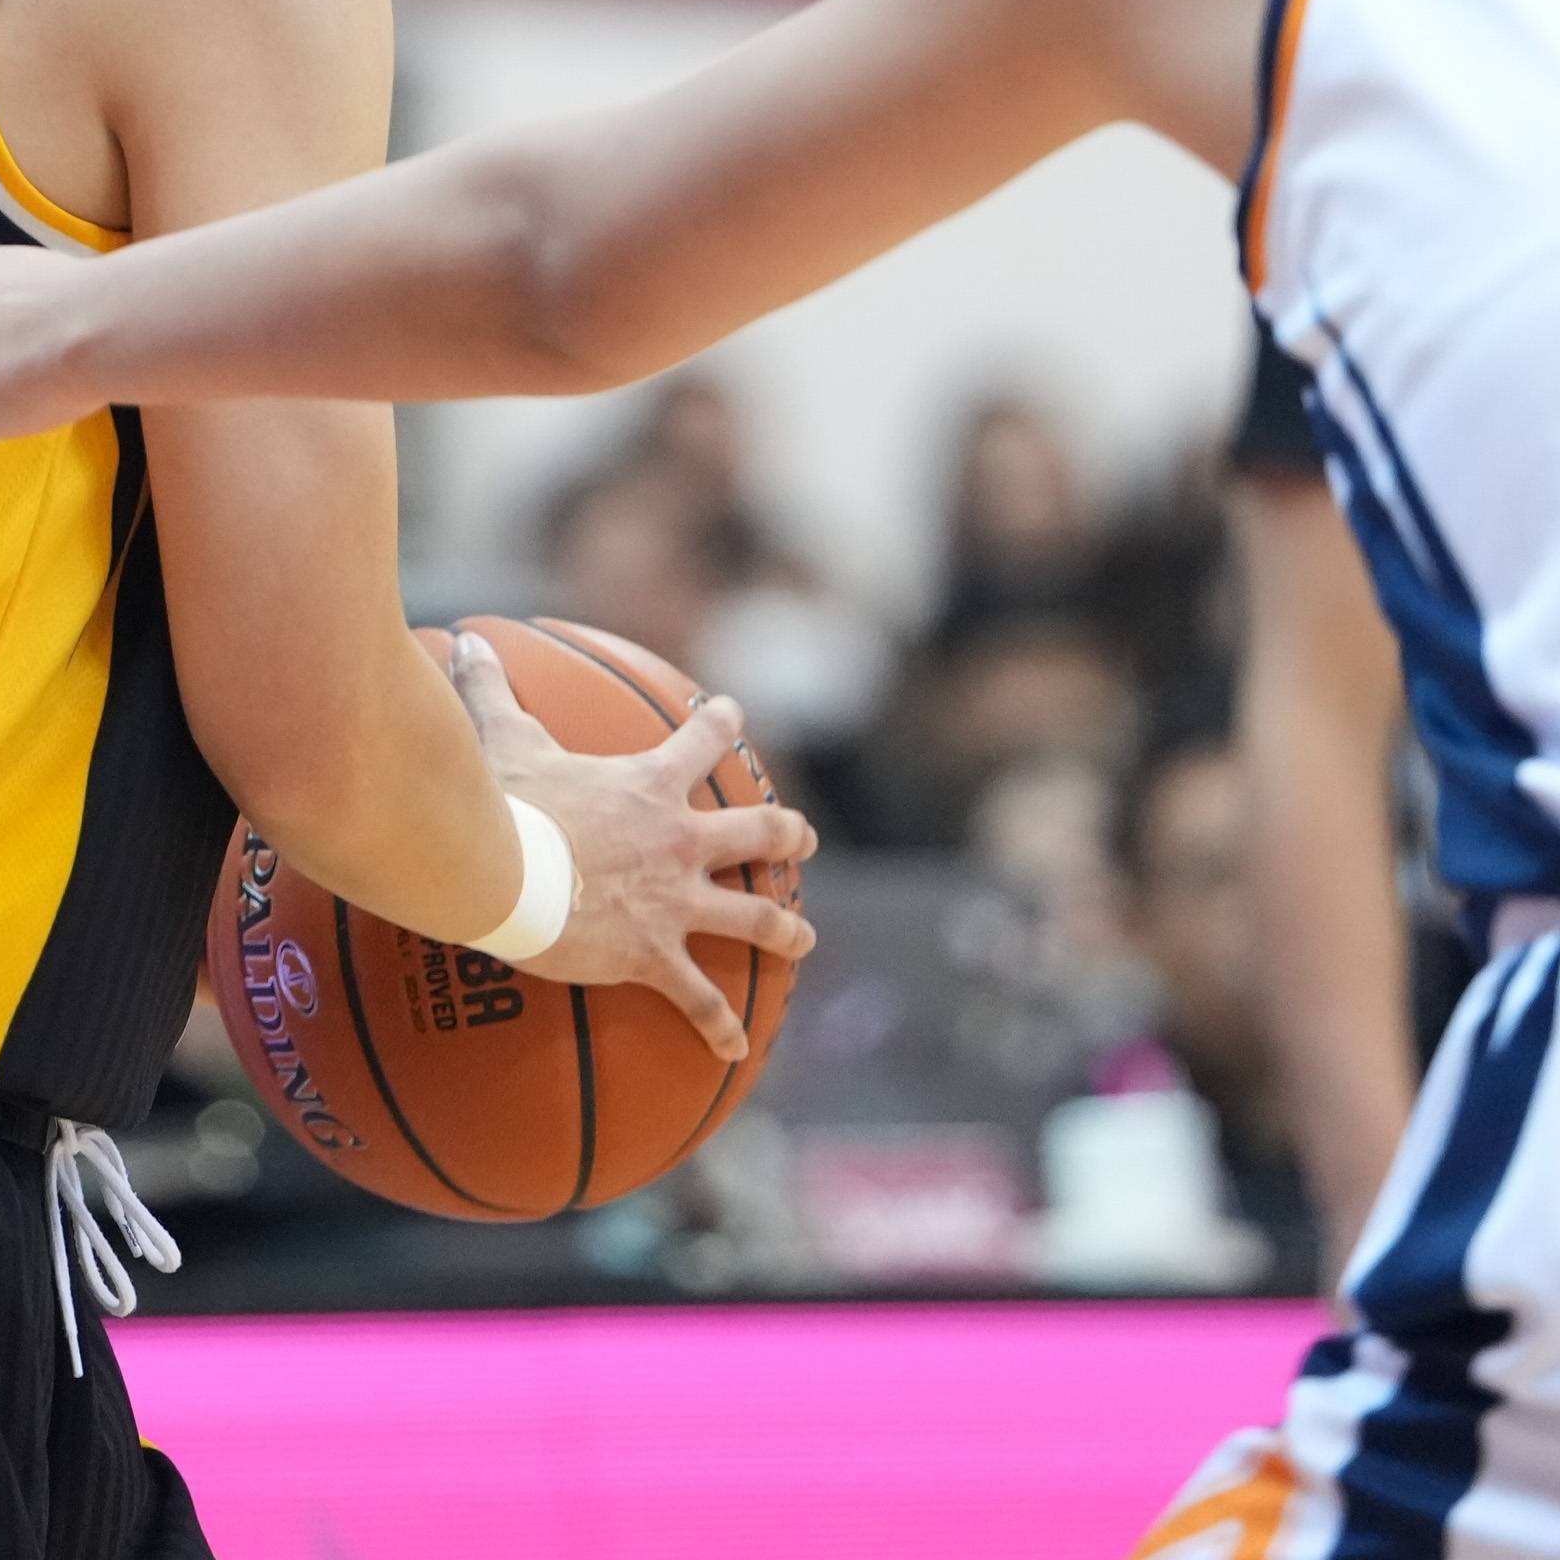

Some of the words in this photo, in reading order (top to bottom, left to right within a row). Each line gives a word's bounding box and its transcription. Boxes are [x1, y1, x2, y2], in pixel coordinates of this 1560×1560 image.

[237, 826, 368, 1150] PALDING
[420, 936, 458, 1032] PROVED
[454, 945, 526, 1028] BA
